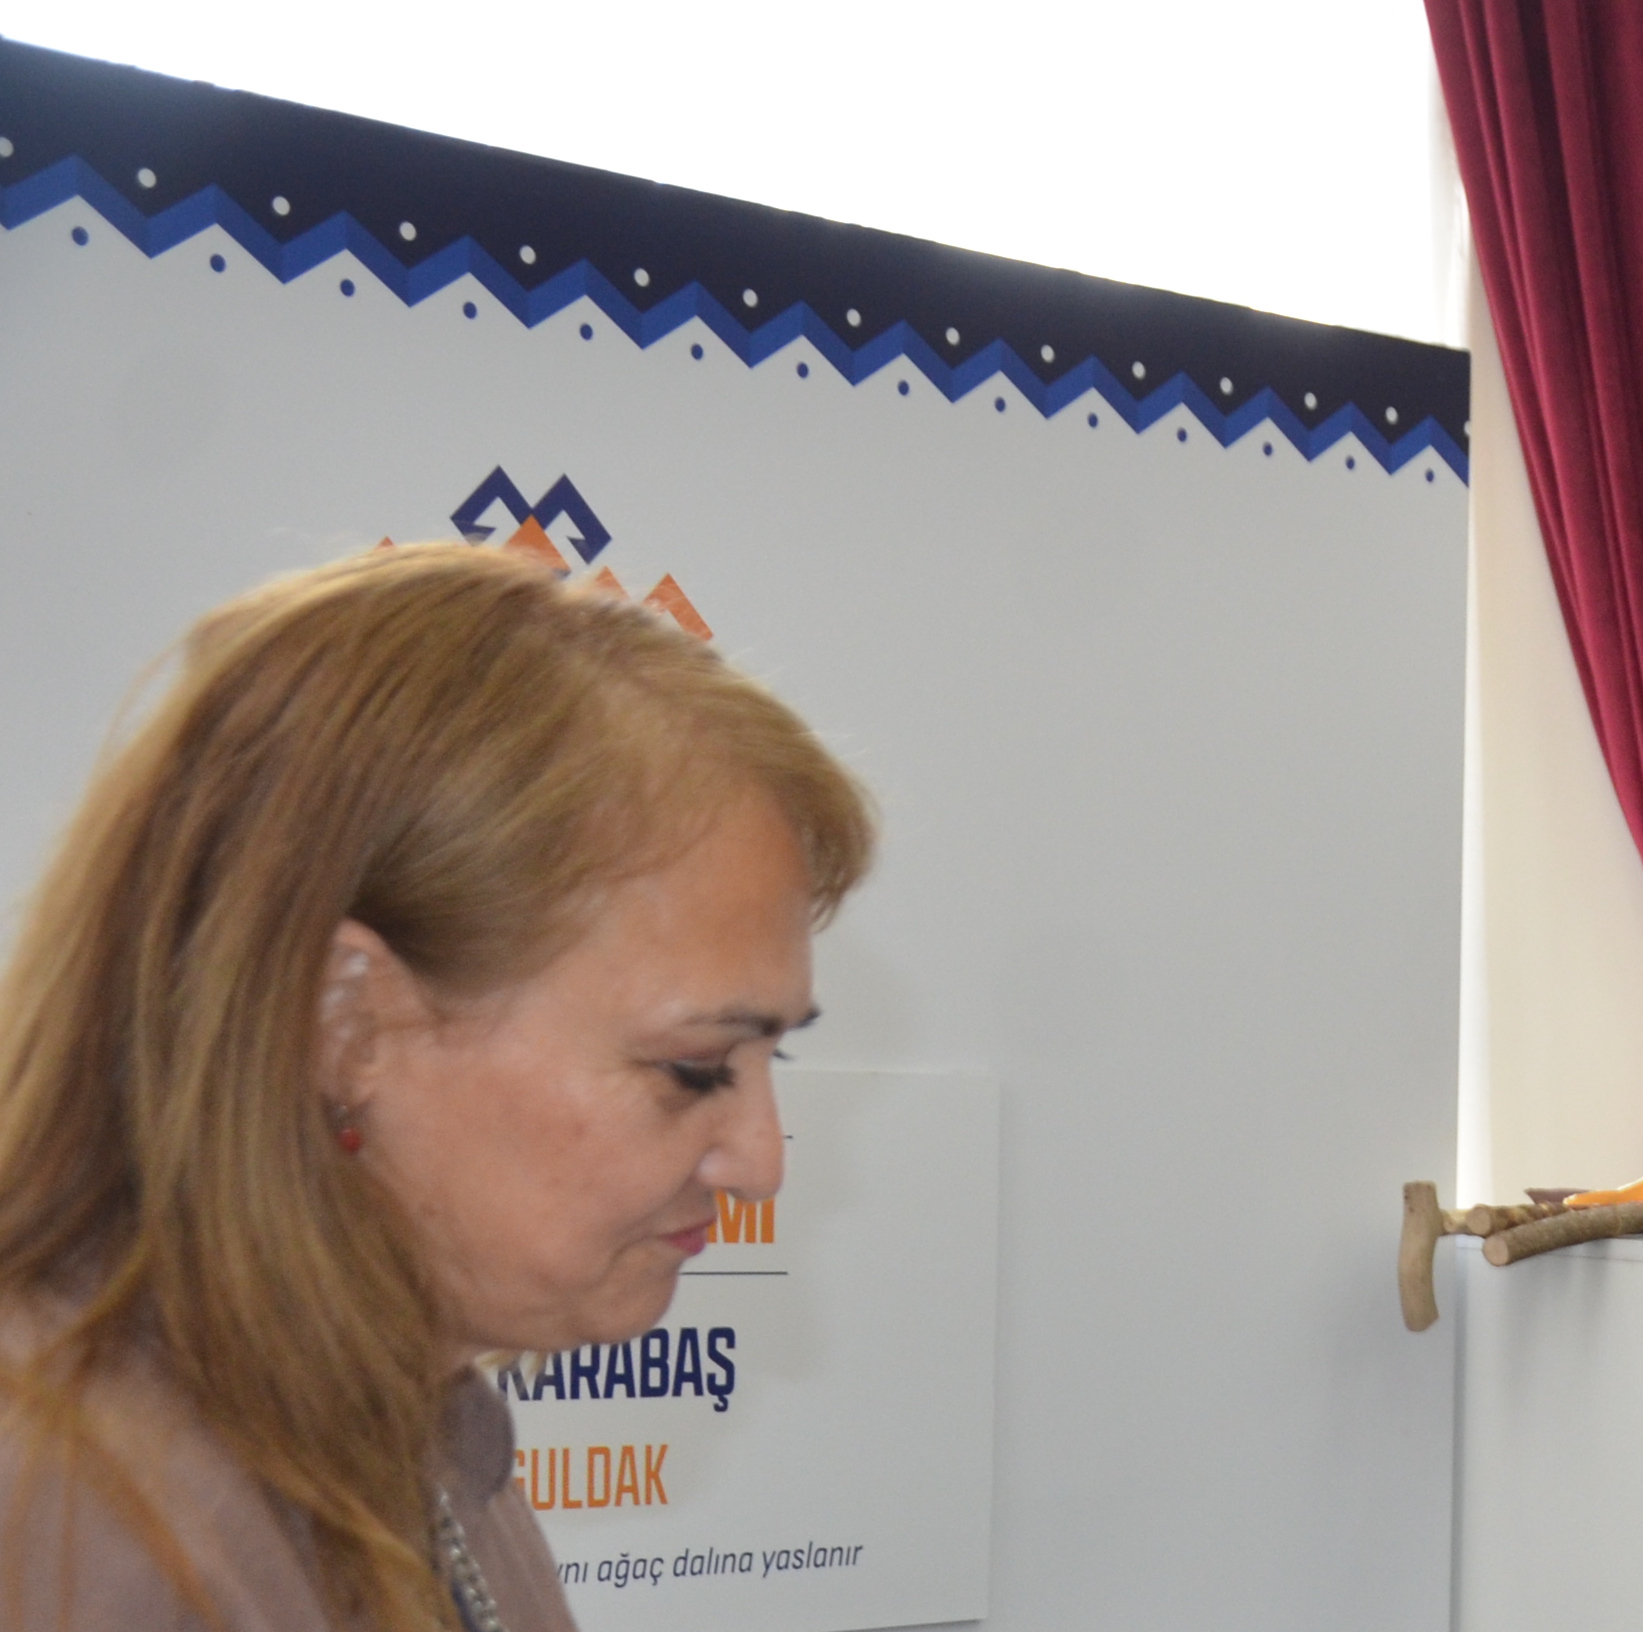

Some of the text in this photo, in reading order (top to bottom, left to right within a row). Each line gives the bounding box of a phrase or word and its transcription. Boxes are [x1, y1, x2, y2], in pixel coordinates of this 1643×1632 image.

[597, 1552, 665, 1588] ağaç
[672, 1547, 754, 1578] dalına
[761, 1541, 864, 1578] yaslanır
